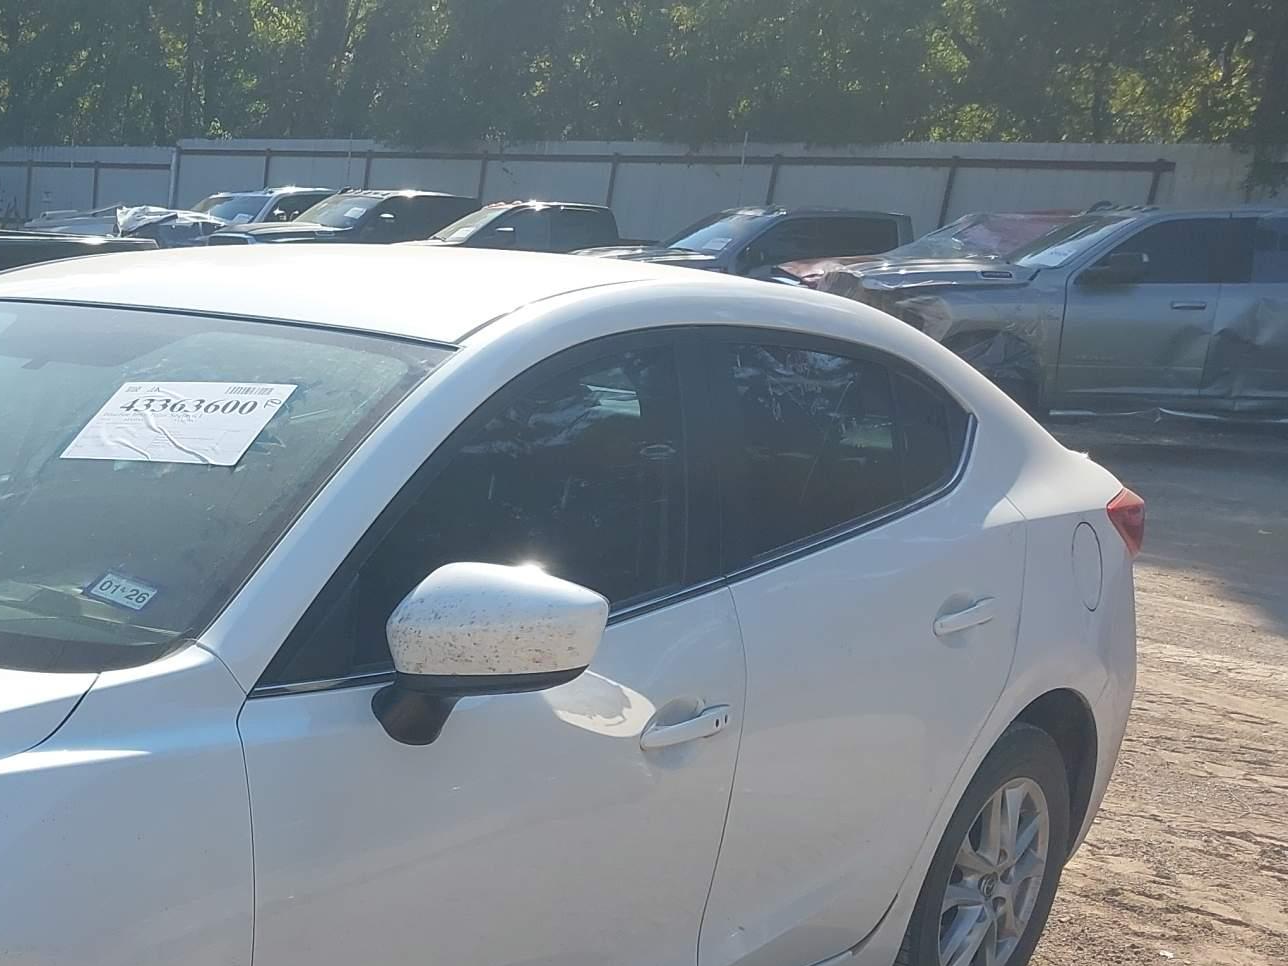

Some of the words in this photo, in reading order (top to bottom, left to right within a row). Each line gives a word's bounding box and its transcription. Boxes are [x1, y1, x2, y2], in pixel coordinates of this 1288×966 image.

[120, 398, 257, 415] 43363600
[99, 580, 121, 594] 01
[124, 588, 150, 604] 26
